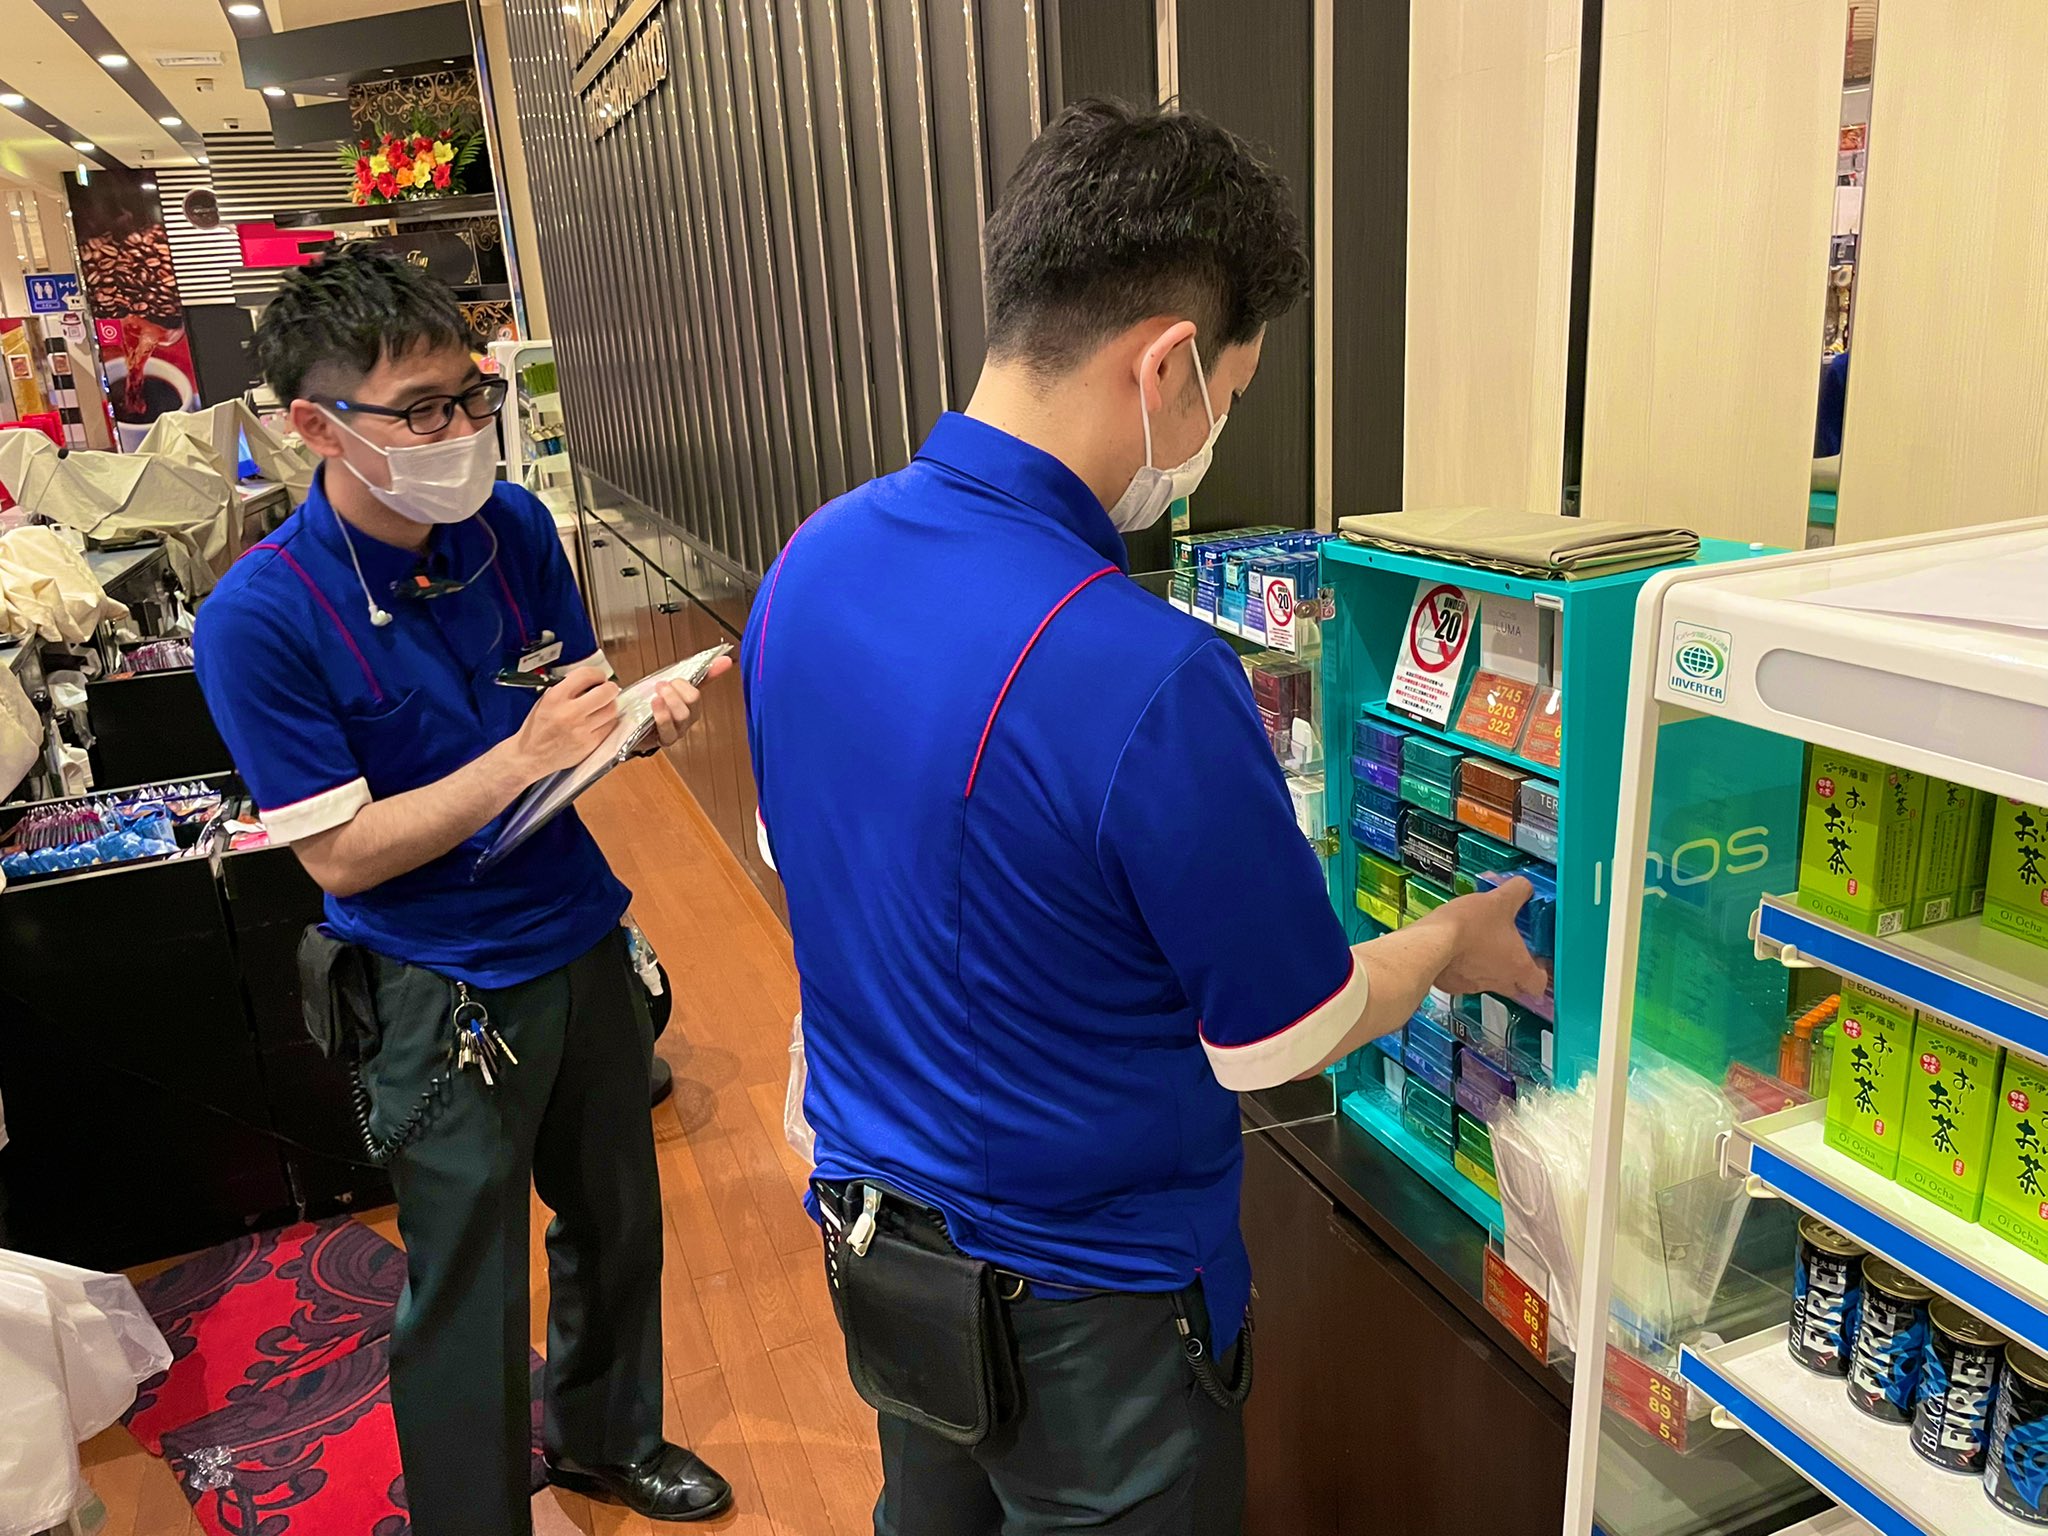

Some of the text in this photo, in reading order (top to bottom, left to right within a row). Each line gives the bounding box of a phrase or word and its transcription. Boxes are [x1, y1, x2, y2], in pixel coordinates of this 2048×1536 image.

[1278, 593, 1289, 610] 20
[1444, 597, 1466, 612] UNDER
[1434, 610, 1463, 643] 20
[1671, 676, 1723, 699] INVERTER
[1488, 718, 1511, 735] 322
[1423, 821, 1449, 840] TEREA
[1824, 803, 1853, 876] お茶
[2014, 811, 2046, 885] お茶
[1812, 900, 1849, 922] Oi Ocha
[2000, 910, 2012, 922] Oi
[2016, 916, 2042, 933] Ocha
[1456, 1021, 1465, 1036] 18
[1851, 1044, 1879, 1115] お茶
[1929, 1080, 1959, 1155] お茶
[1839, 1132, 1850, 1144] Oi
[1852, 1140, 1875, 1159] Ocha
[2015, 1118, 2046, 1198] お茶
[1915, 1172, 1926, 1184] Oi
[1929, 1181, 1954, 1201] Ocha
[1998, 1214, 2009, 1227] Oi
[2013, 1224, 2039, 1245] Ocha
[1523, 1291, 1539, 1314] 25
[1803, 1266, 1847, 1358] FIRE
[1523, 1308, 1539, 1331] 89
[1791, 1294, 1806, 1350] BLACK
[1530, 1333, 1538, 1349] 5
[1853, 1300, 1896, 1400] FIRE
[1649, 1378, 1672, 1401] 25
[1649, 1397, 1671, 1420] 89
[1941, 1360, 1995, 1451] FIRE
[1659, 1422, 1670, 1439] 5
[1922, 1392, 1946, 1452] BLACK
